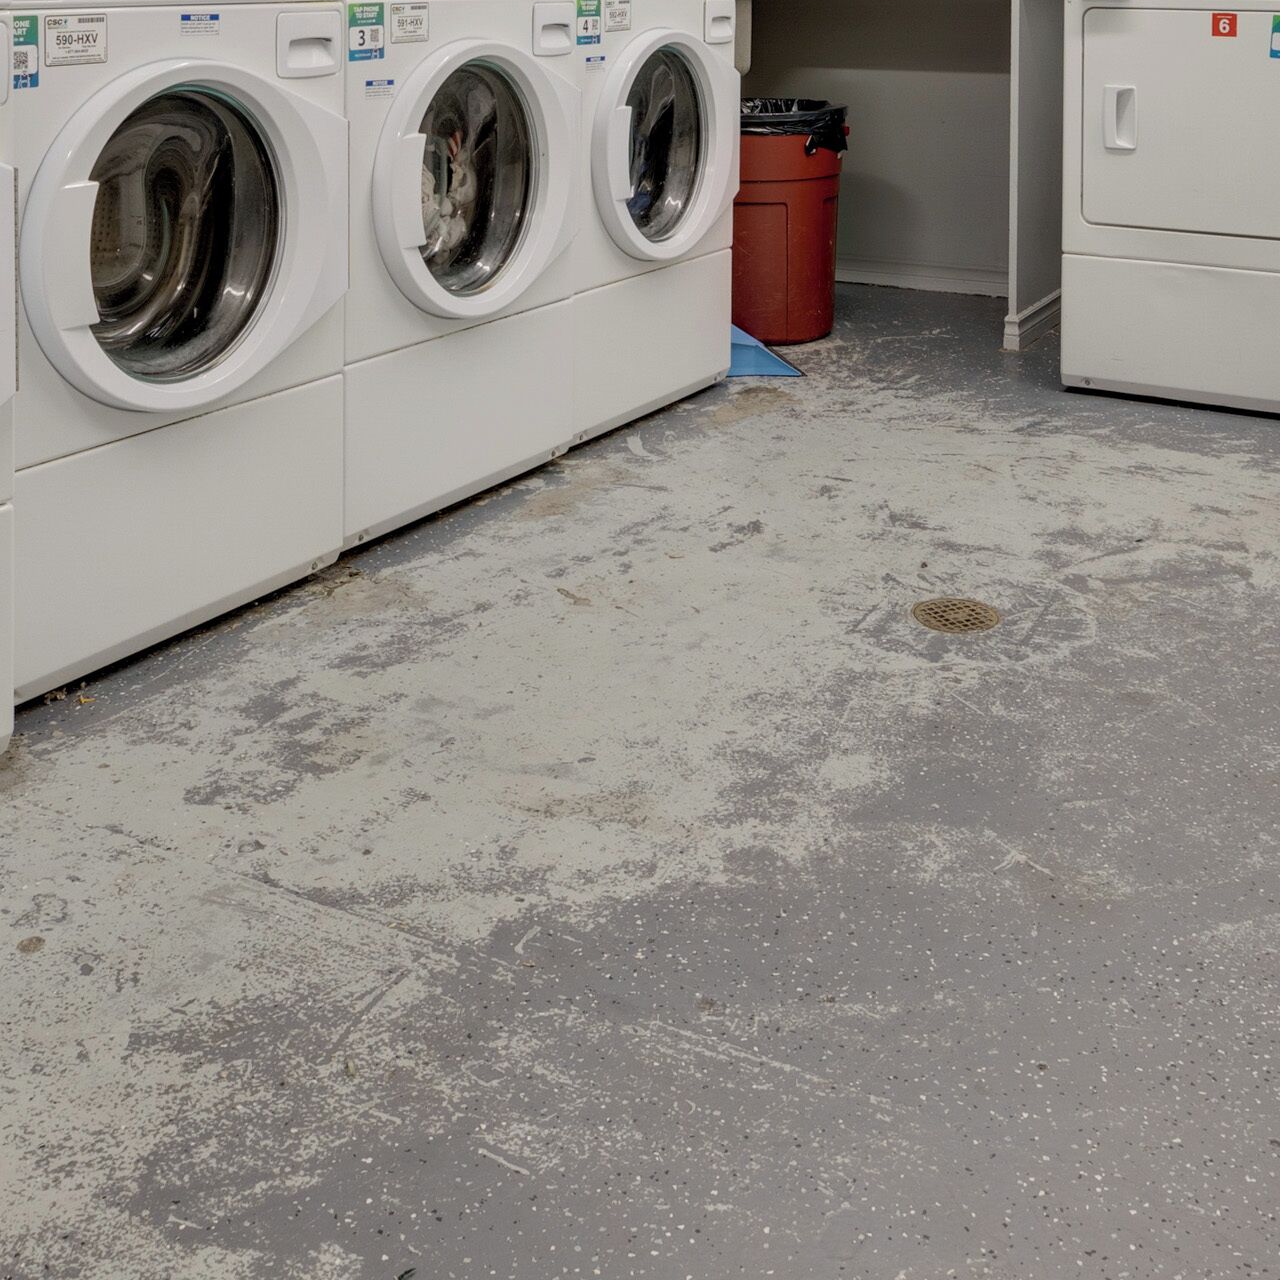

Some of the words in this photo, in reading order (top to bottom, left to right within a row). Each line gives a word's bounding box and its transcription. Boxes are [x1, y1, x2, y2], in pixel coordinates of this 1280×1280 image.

[14, 20, 30, 28] ONE
[583, 20, 588, 32] 4
[1219, 19, 1230, 33] 6
[56, 33, 98, 46] 590-HXV
[358, 30, 365, 46] 3
